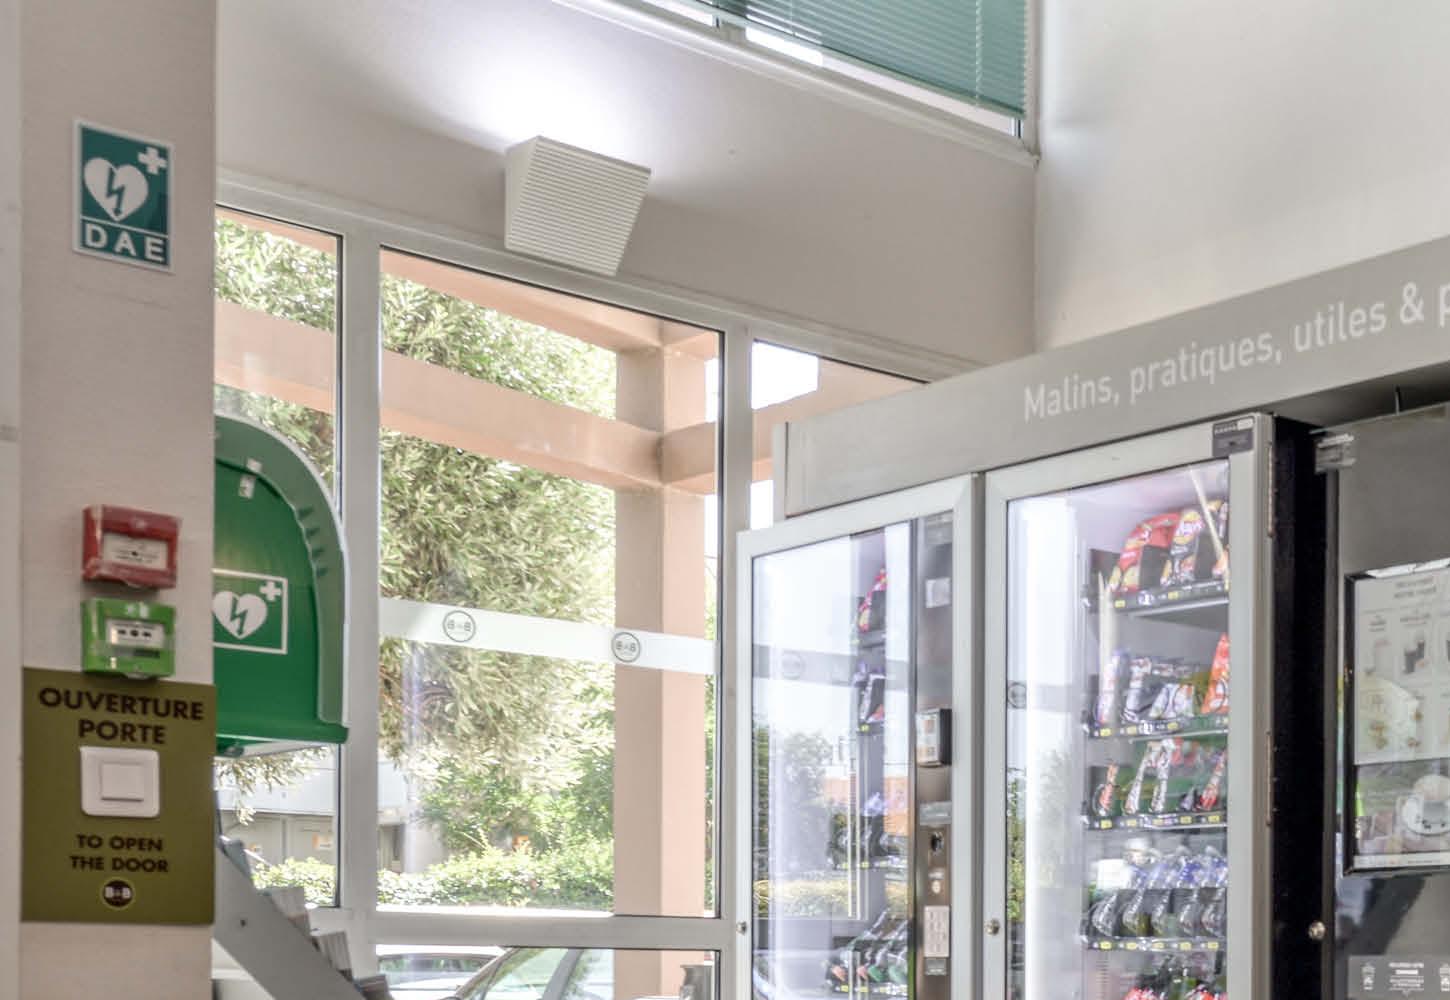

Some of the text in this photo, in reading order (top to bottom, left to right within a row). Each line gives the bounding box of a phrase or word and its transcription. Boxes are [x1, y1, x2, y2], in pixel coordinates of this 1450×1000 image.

[85, 223, 165, 262] DAE
[1024, 373, 1120, 420] Malins,
[1130, 332, 1283, 405] pratiques,
[1294, 301, 1387, 352] utiles
[1400, 281, 1425, 325] &
[39, 687, 204, 721] OUVERTURE
[78, 719, 165, 744] PORTE
[76, 834, 163, 851] TO OPEN
[70, 855, 169, 873] THE DOOR
